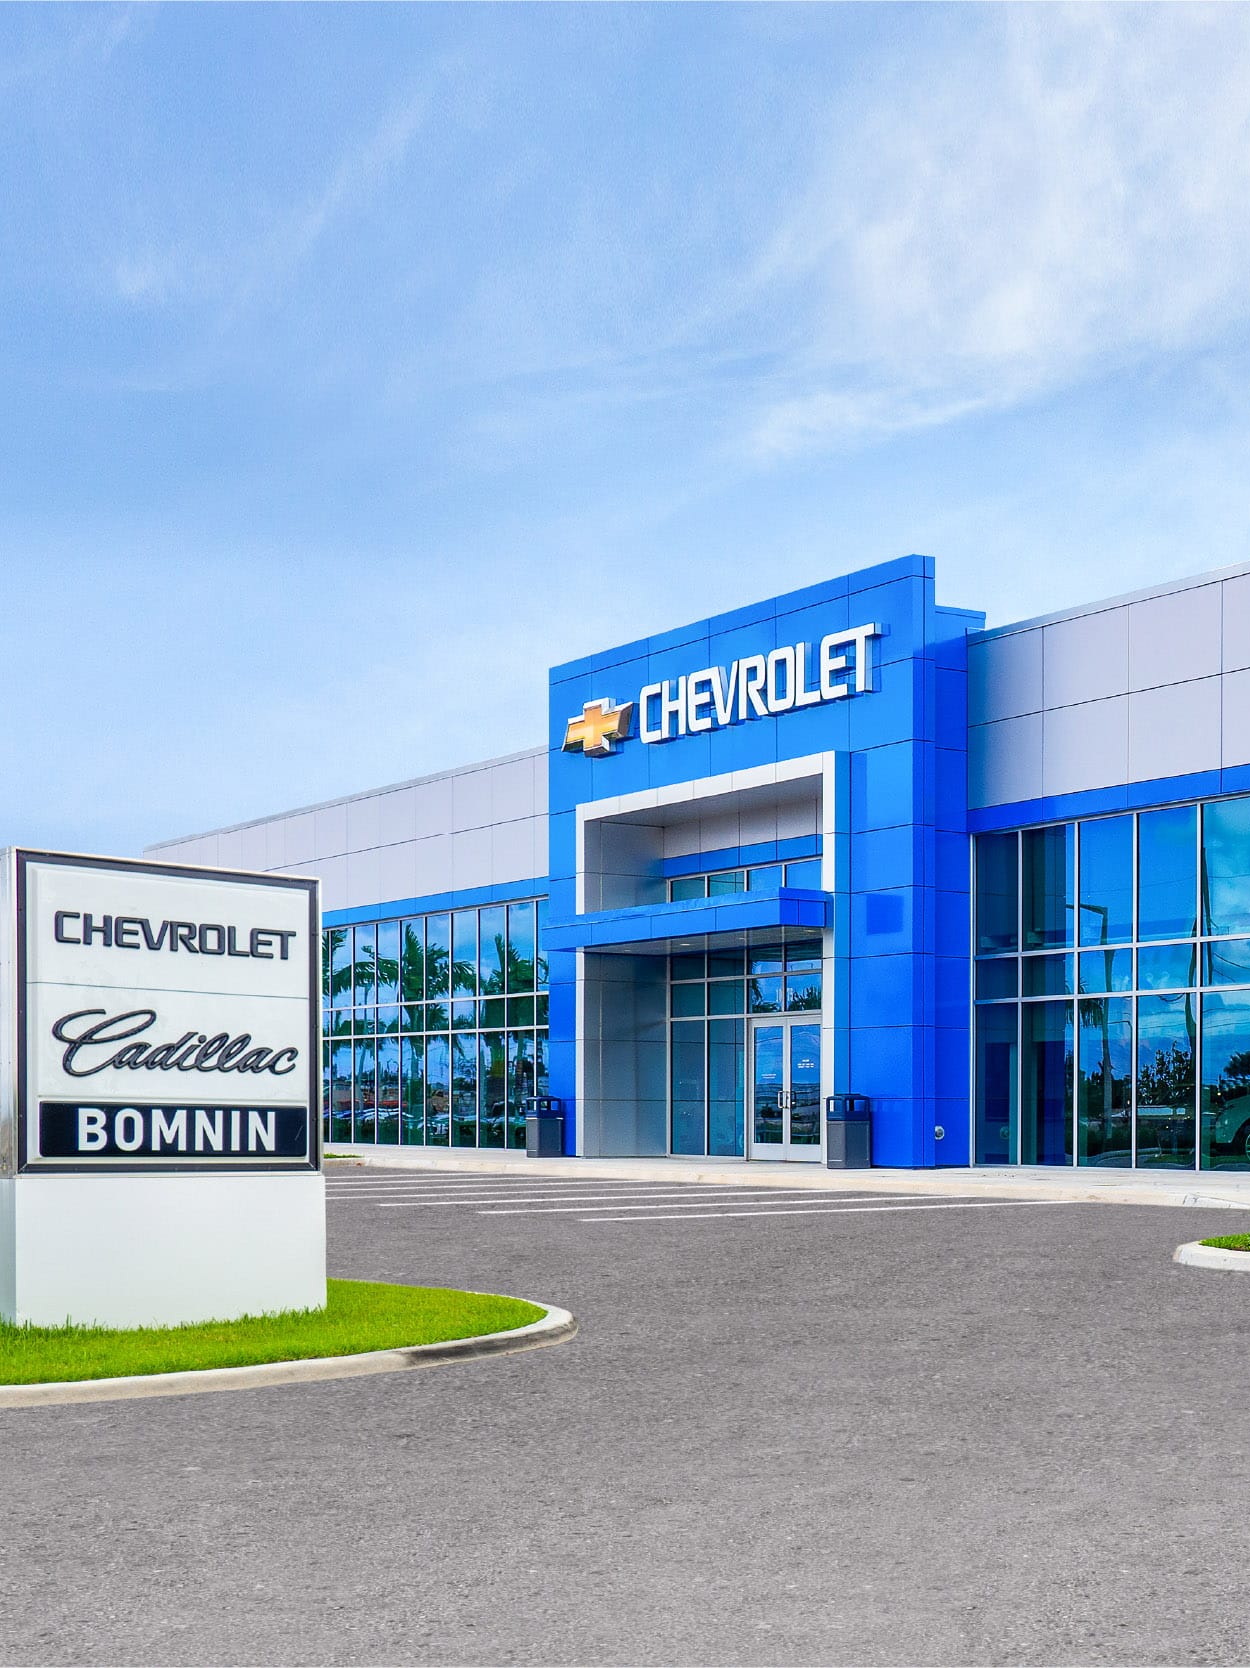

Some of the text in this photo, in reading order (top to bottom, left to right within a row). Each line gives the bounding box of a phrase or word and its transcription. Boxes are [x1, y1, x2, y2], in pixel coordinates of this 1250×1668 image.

[639, 622, 882, 744] CHEVROLET
[54, 910, 297, 960] CHEVROLET
[51, 1008, 299, 1077] Cadillac
[77, 1108, 276, 1151] BOMNIN
